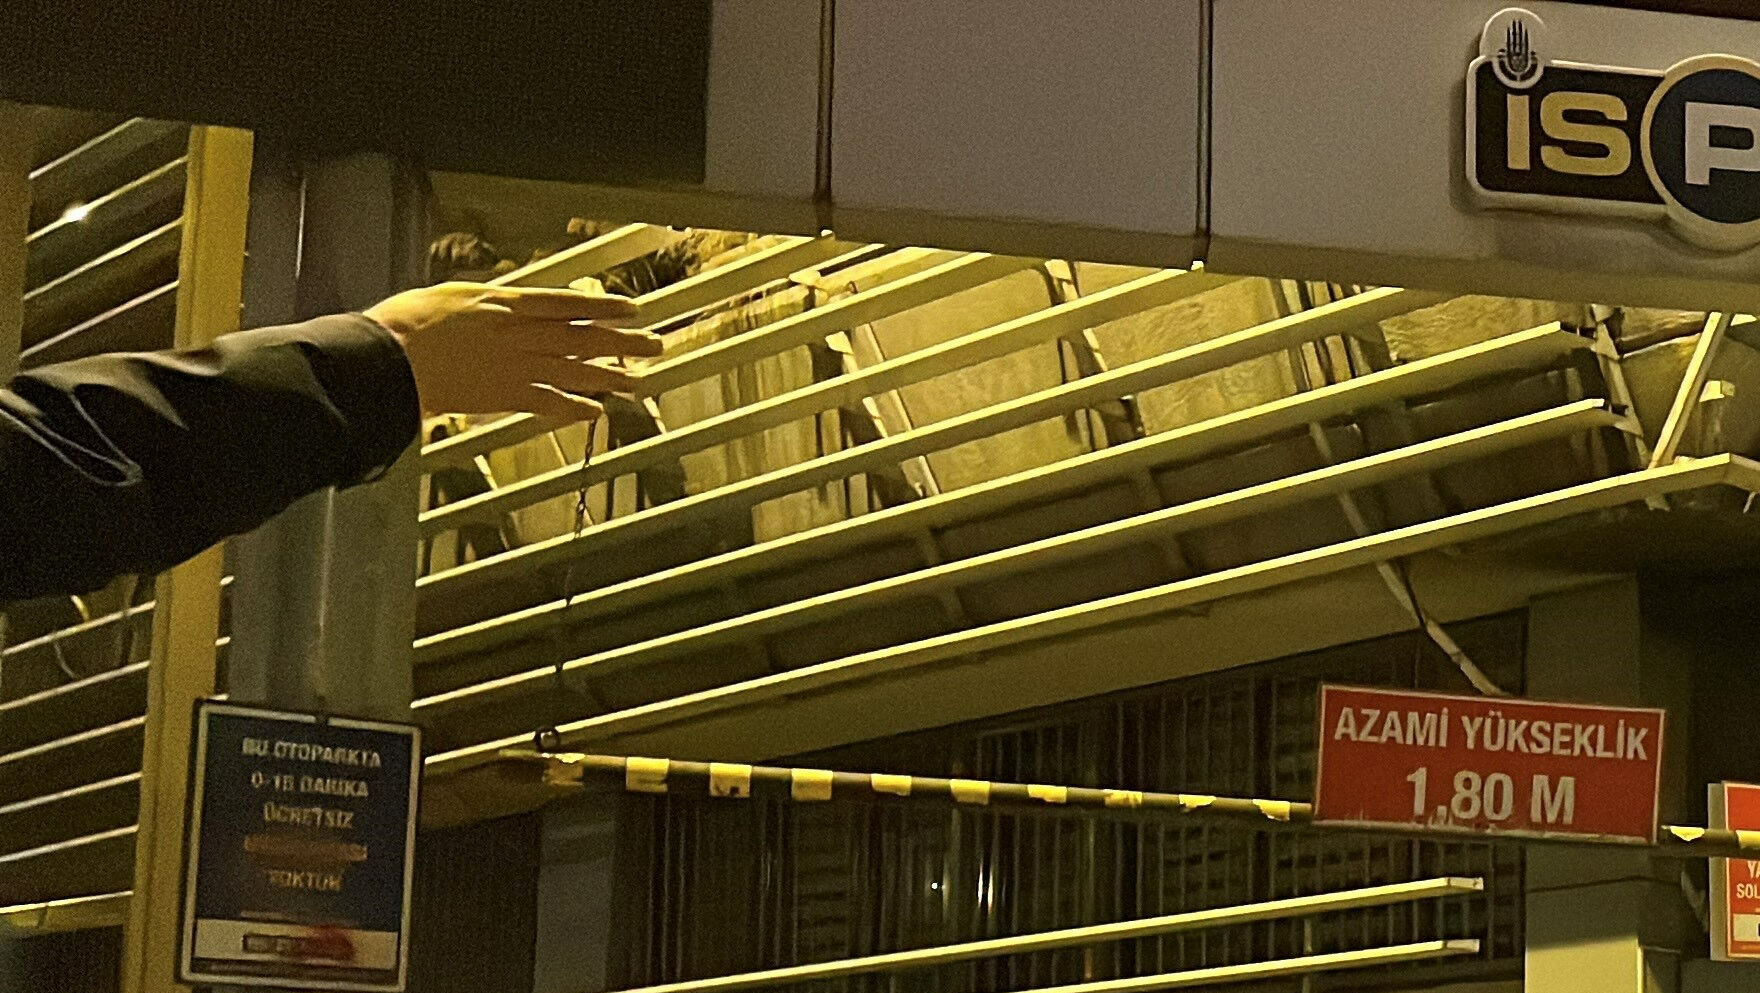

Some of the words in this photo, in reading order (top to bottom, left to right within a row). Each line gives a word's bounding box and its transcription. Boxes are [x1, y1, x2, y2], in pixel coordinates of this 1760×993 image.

[1333, 706, 1449, 748] AZAMİ
[1461, 709, 1648, 761] YÜKSEKLİK
[1530, 774, 1576, 825] M
